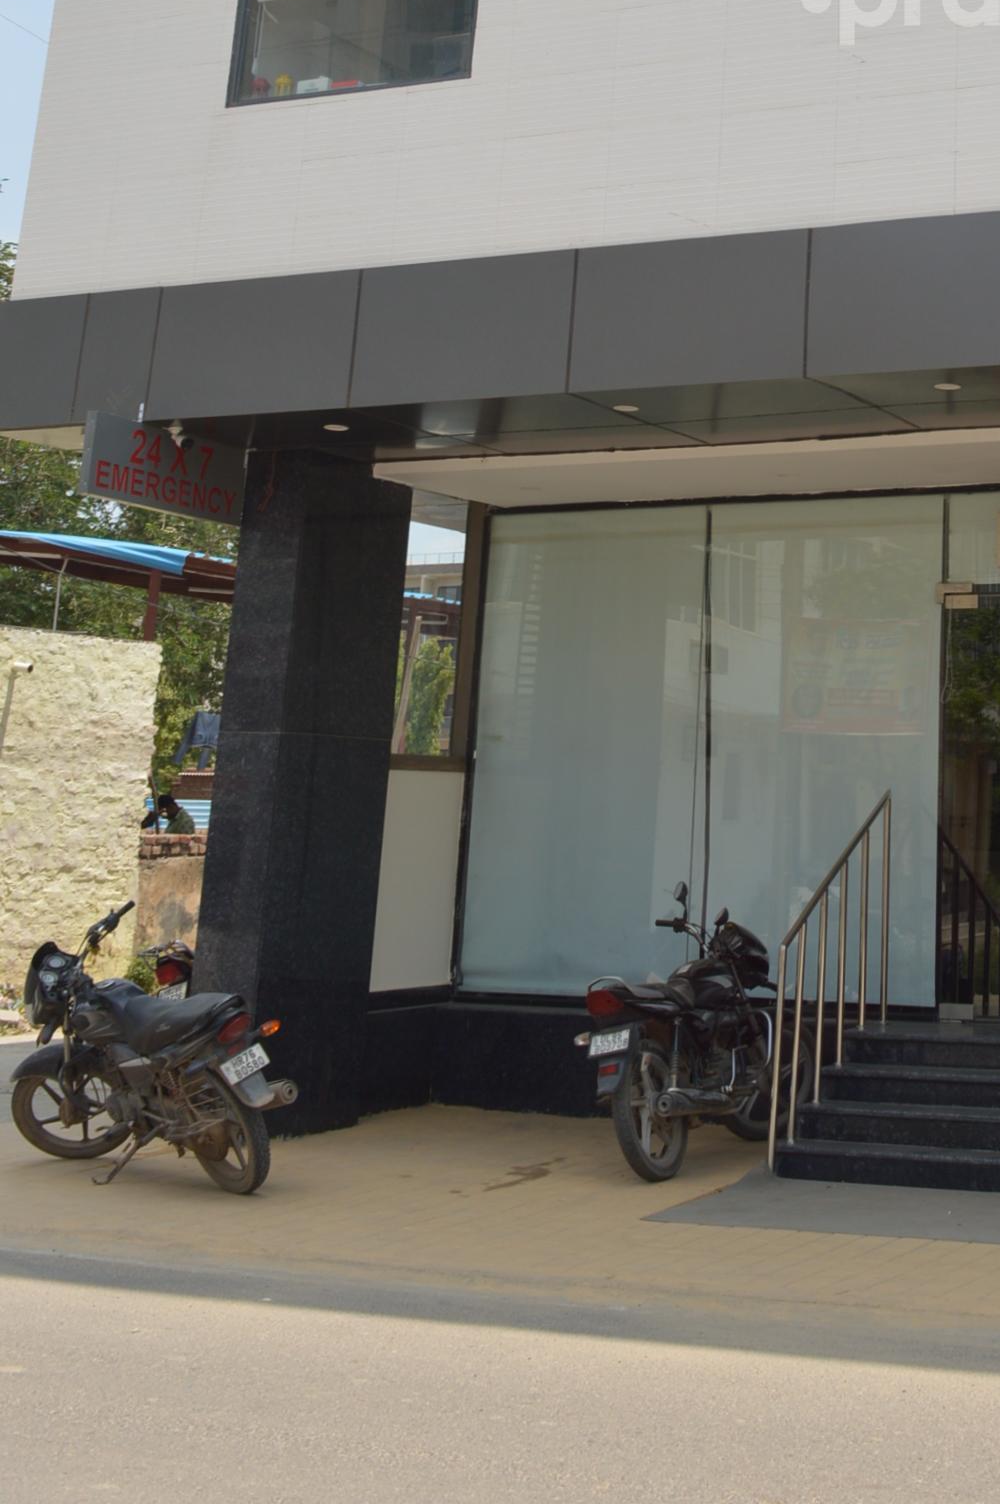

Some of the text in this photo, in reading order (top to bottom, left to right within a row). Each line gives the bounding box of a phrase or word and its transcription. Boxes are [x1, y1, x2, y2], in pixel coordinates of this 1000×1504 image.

[129, 428, 162, 469] 24
[199, 446, 215, 481] 7
[95, 459, 237, 516] EMERGENCY
